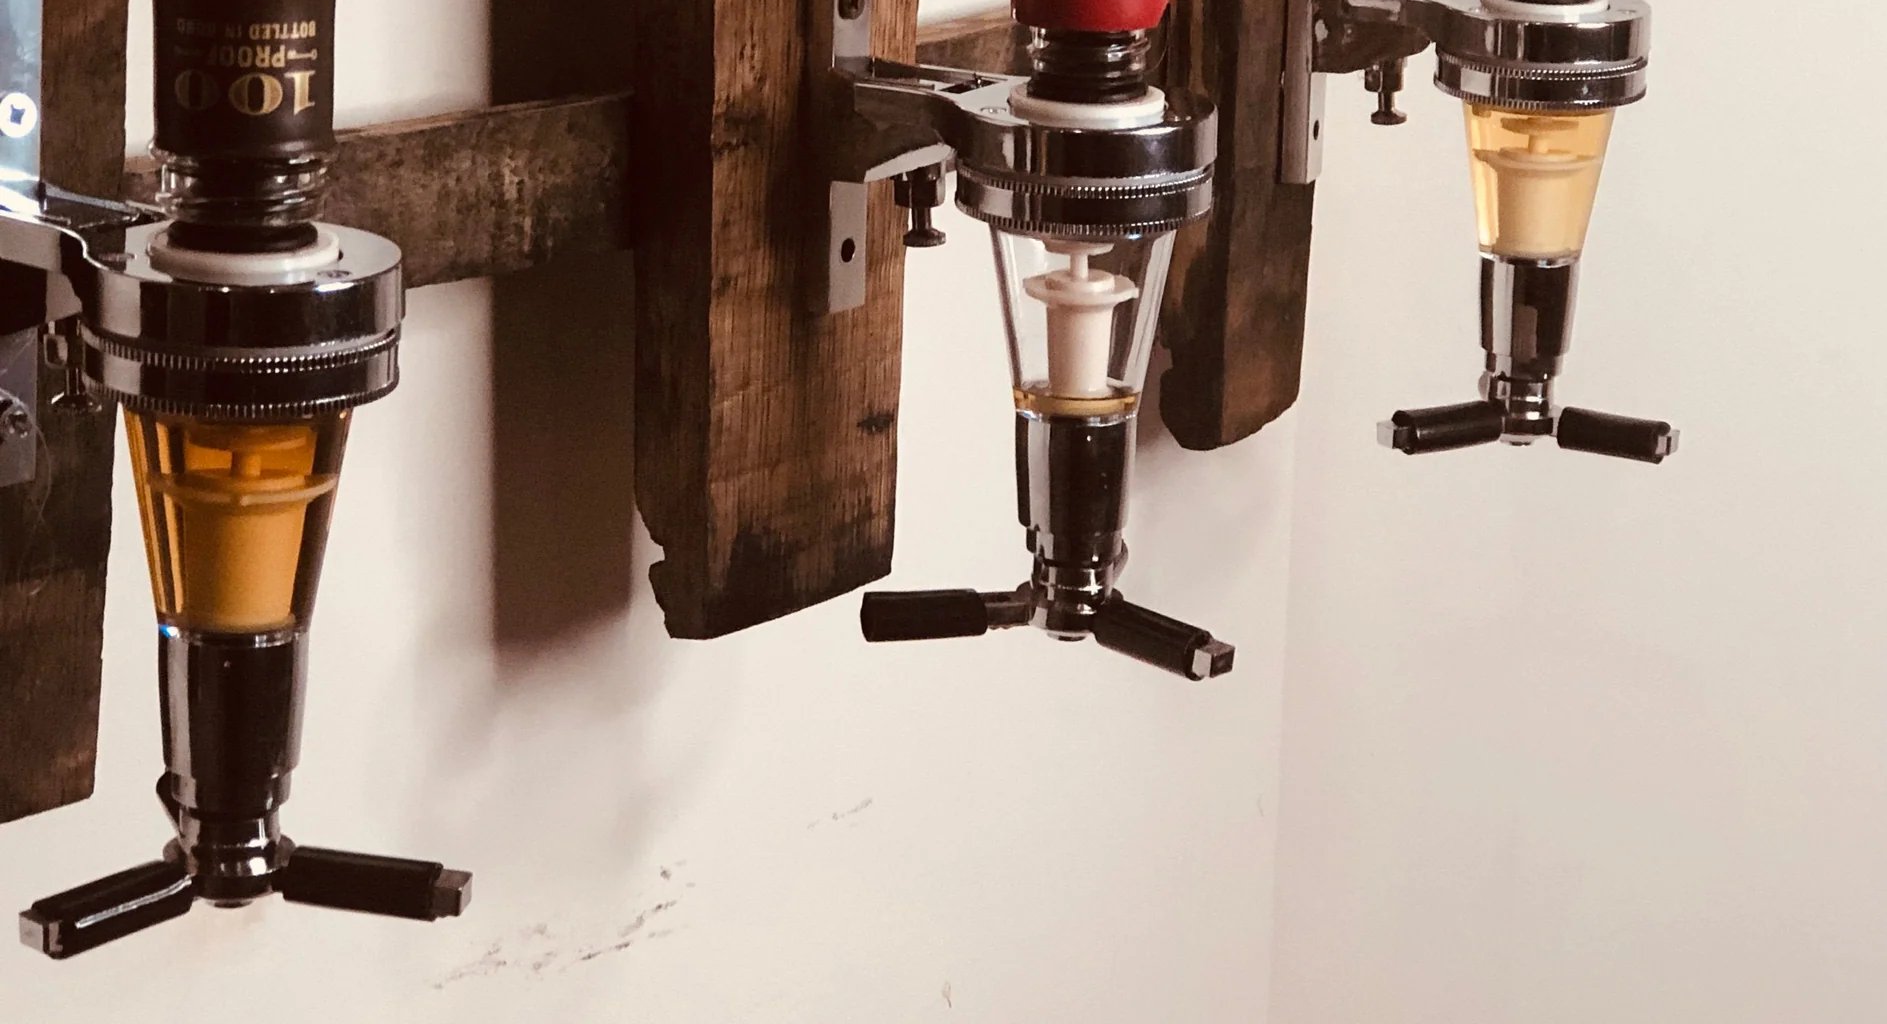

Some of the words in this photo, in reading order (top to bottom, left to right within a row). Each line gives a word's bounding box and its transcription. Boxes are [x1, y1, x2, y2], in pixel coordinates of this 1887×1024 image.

[225, 24, 242, 38] IN
[250, 20, 316, 39] BOTTLED
[207, 44, 286, 68] PROOF
[174, 69, 315, 116] 100
